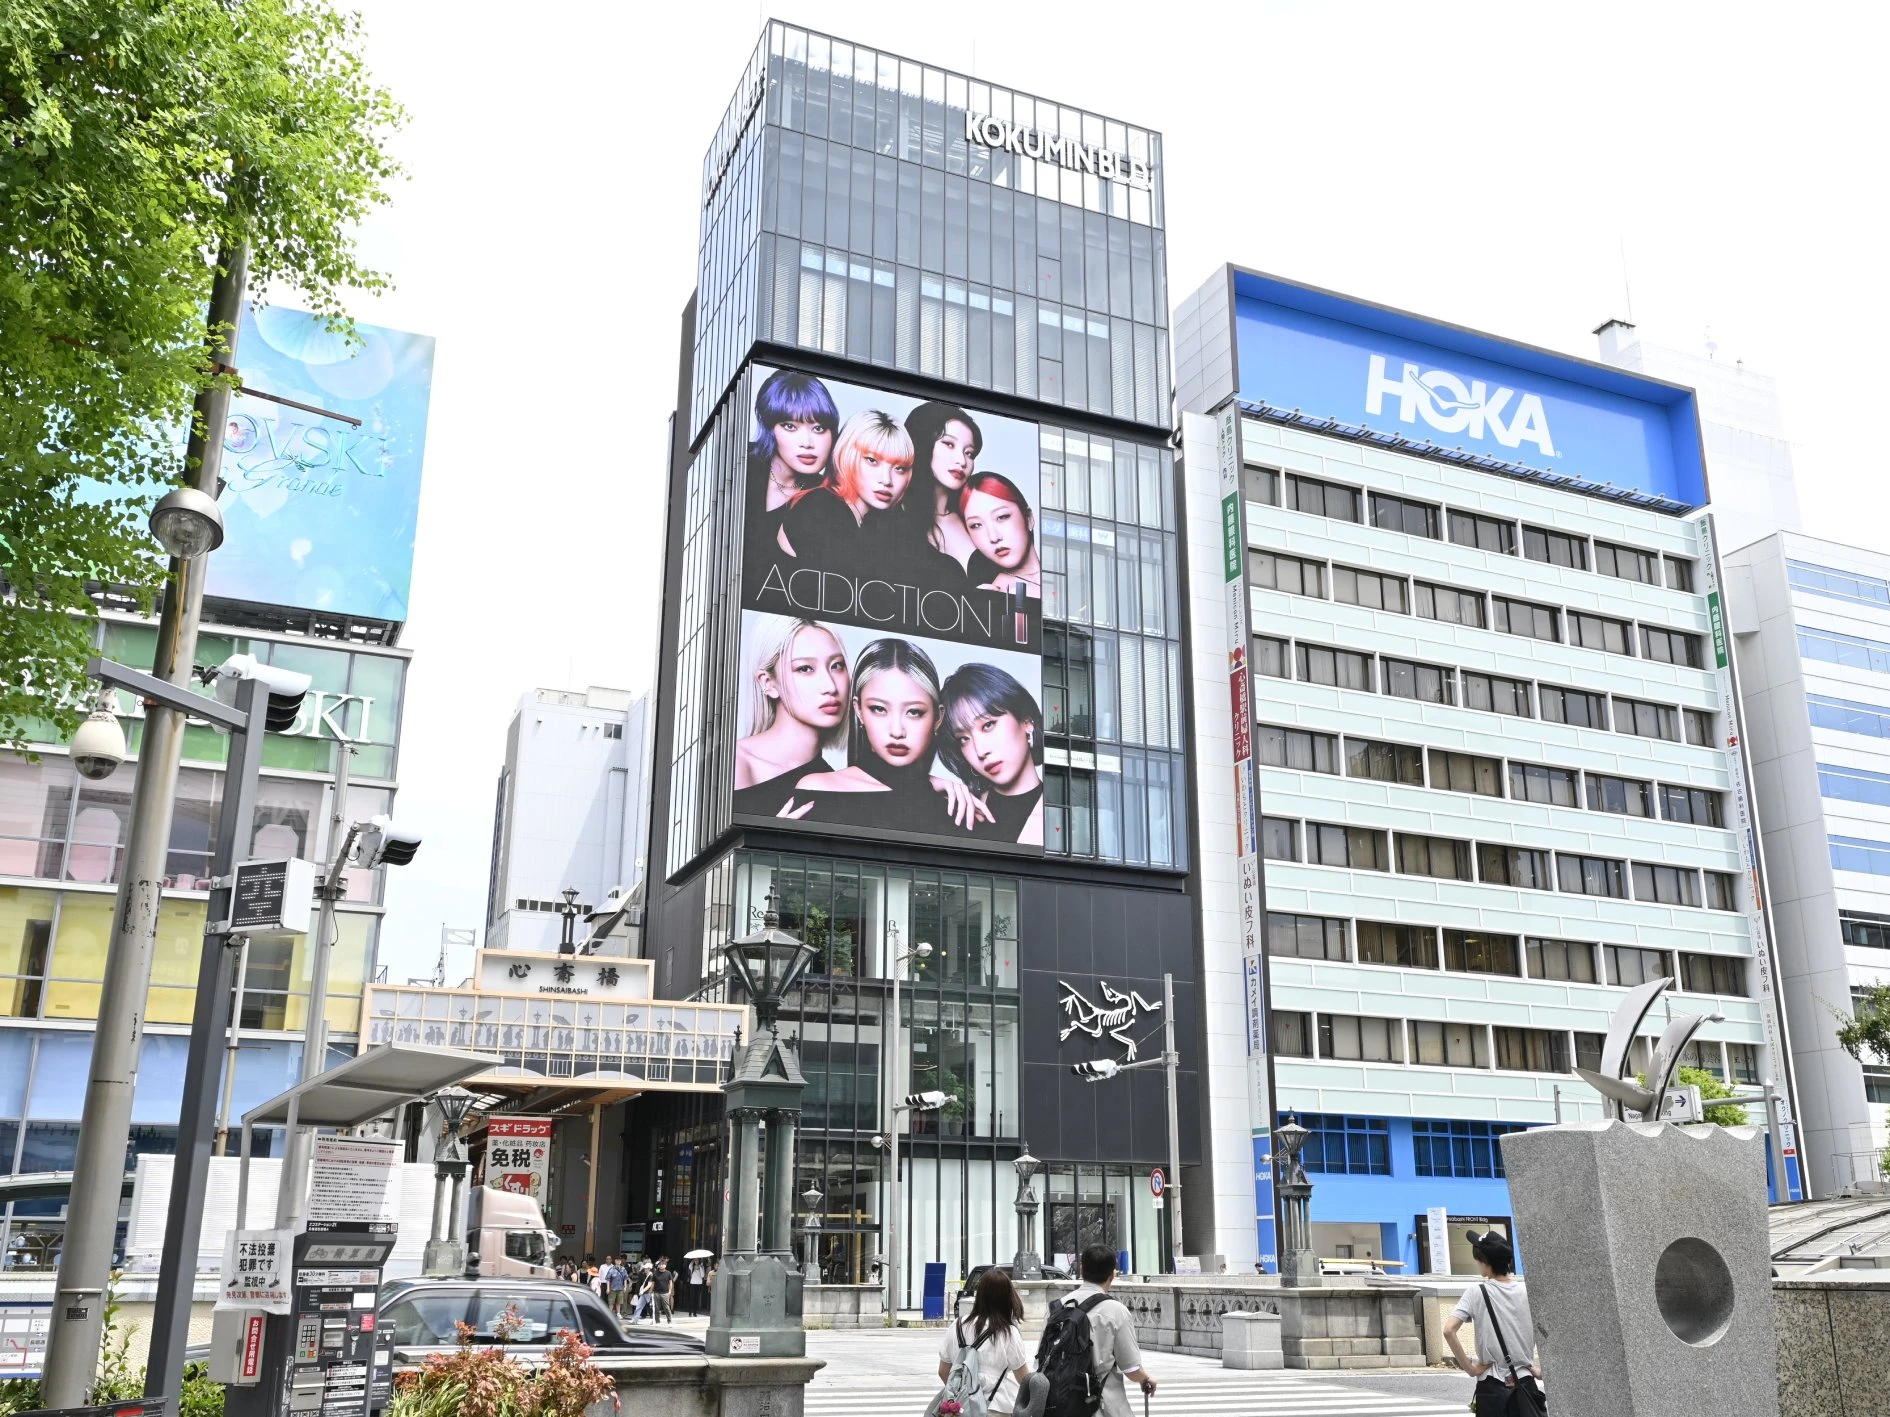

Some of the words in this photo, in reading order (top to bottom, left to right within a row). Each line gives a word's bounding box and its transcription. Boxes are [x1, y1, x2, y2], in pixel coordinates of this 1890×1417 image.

[965, 111, 1095, 174] KOKUMIN
[1365, 354, 1555, 457] HOKA
[756, 563, 991, 638] ADDICTION
[1243, 863, 1255, 950] いぬい皮フ科
[508, 962, 620, 987] 心斎橋
[1757, 941, 1770, 993] いぬい皮フ科
[539, 985, 588, 995] SHINSAIBASHI
[492, 1139, 523, 1147] 薬・化粧品
[490, 1147, 531, 1168] 免税
[504, 1174, 529, 1195] くすり
[1256, 1171, 1272, 1181] HOKA
[240, 1243, 276, 1257] 不法投棄
[1260, 1254, 1276, 1263] HOKA
[238, 1258, 274, 1272] 犯罪です
[244, 1276, 266, 1288] 監視中
[246, 1319, 260, 1375] お問合せ用電話
